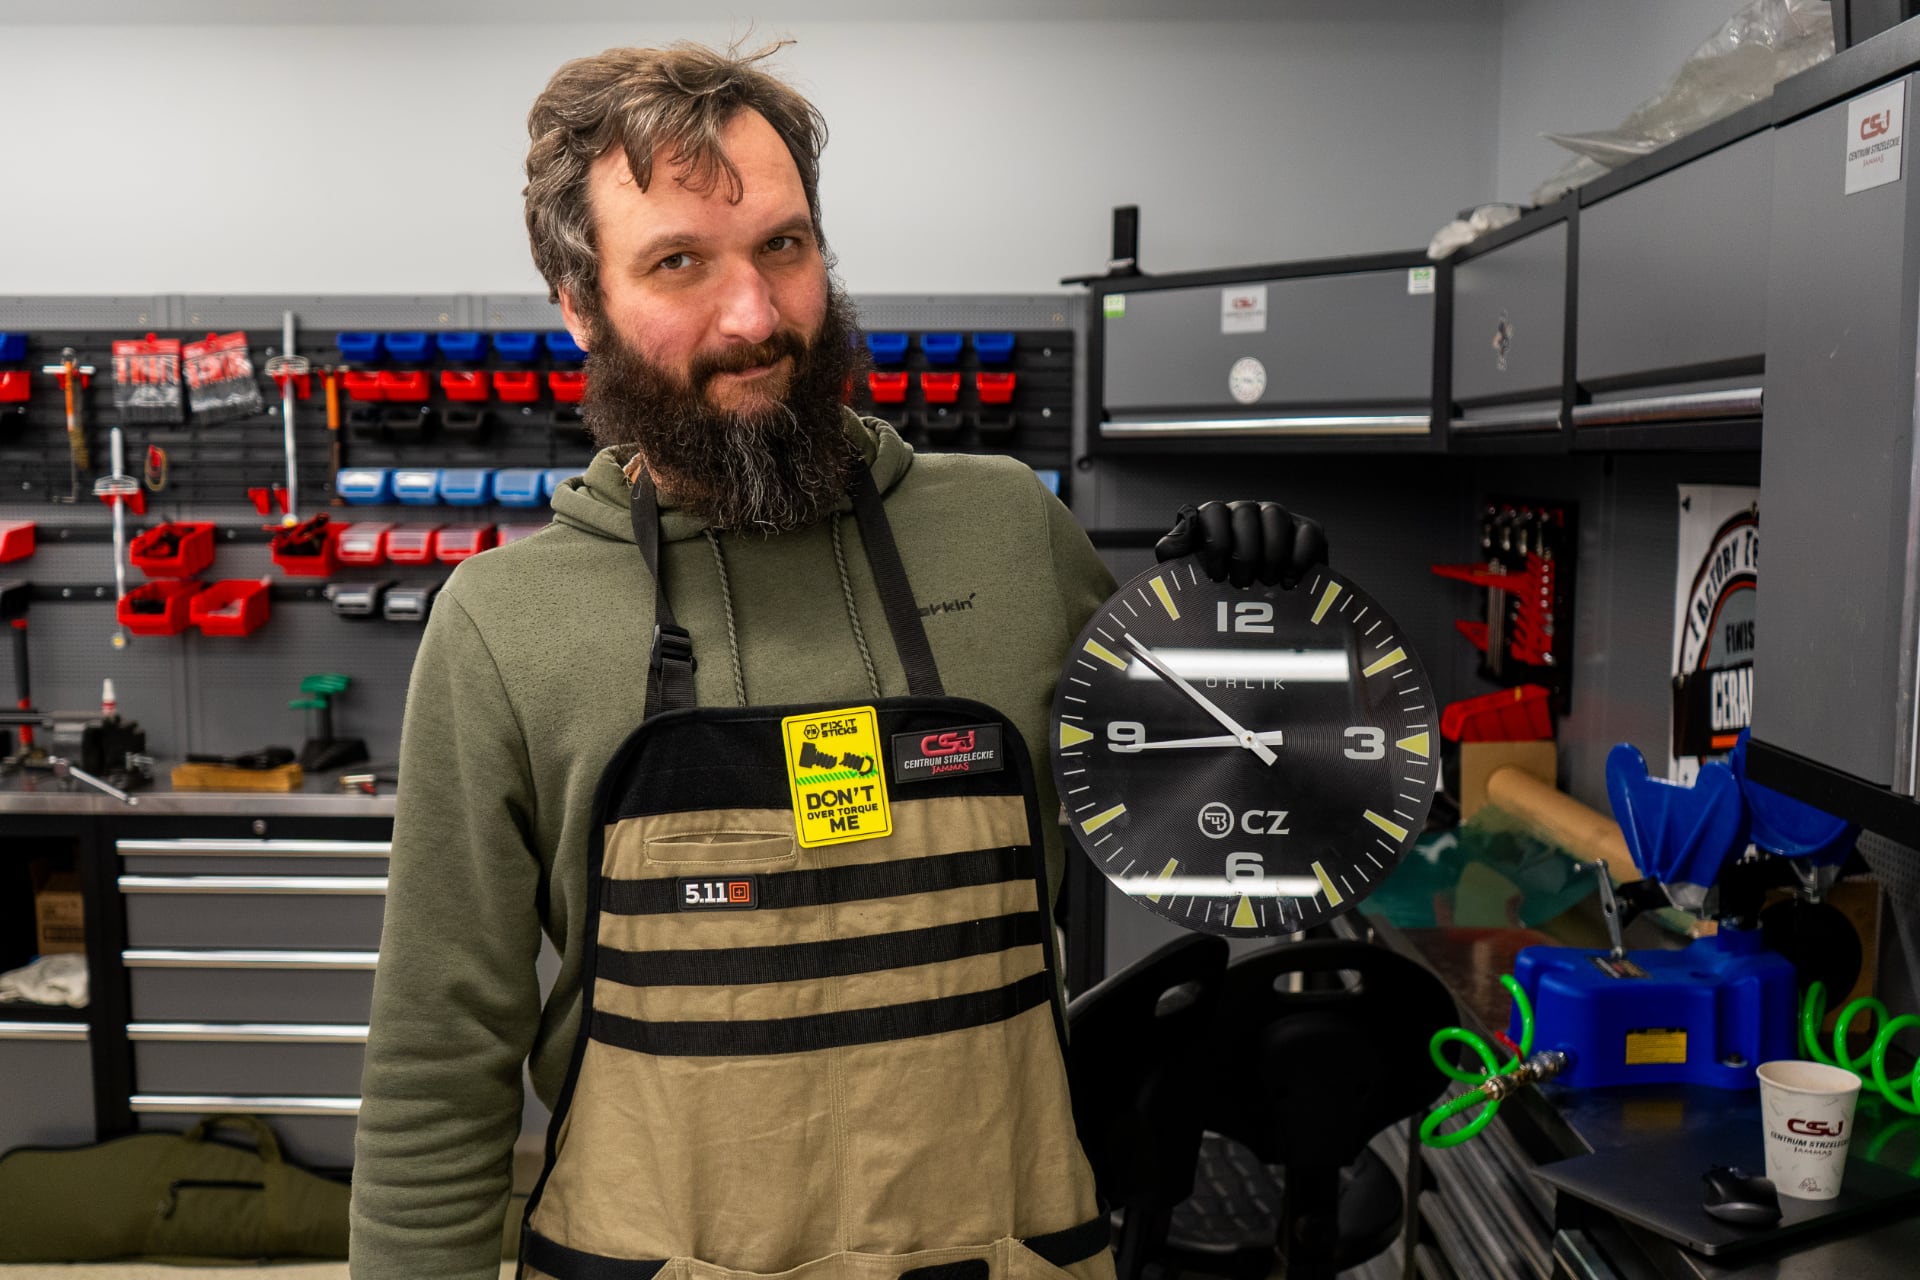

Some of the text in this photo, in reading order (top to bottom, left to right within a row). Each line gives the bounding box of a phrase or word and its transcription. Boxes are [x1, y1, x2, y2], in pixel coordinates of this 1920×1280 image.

[1860, 109, 1890, 140] CSJ
[1848, 146, 1871, 162] CENTRUM
[1217, 601, 1274, 633] 12
[1205, 675, 1285, 690] ORLIK
[820, 718, 857, 730] FIX IT
[821, 726, 858, 738] STICKS
[920, 729, 975, 757] CSJ
[1106, 721, 1146, 753] 9
[1343, 726, 1385, 760] 3
[904, 750, 994, 770] CENTRUM STRZELECKIE
[805, 785, 875, 810] DON'T
[807, 803, 879, 821] OVER TORQUE
[1241, 810, 1290, 835] CZ
[830, 815, 860, 833] ME
[1226, 851, 1264, 883] 6
[685, 882, 728, 904] 5.11
[1787, 1117, 1844, 1137] CSJ
[1770, 1131, 1807, 1147] CENTRUM
